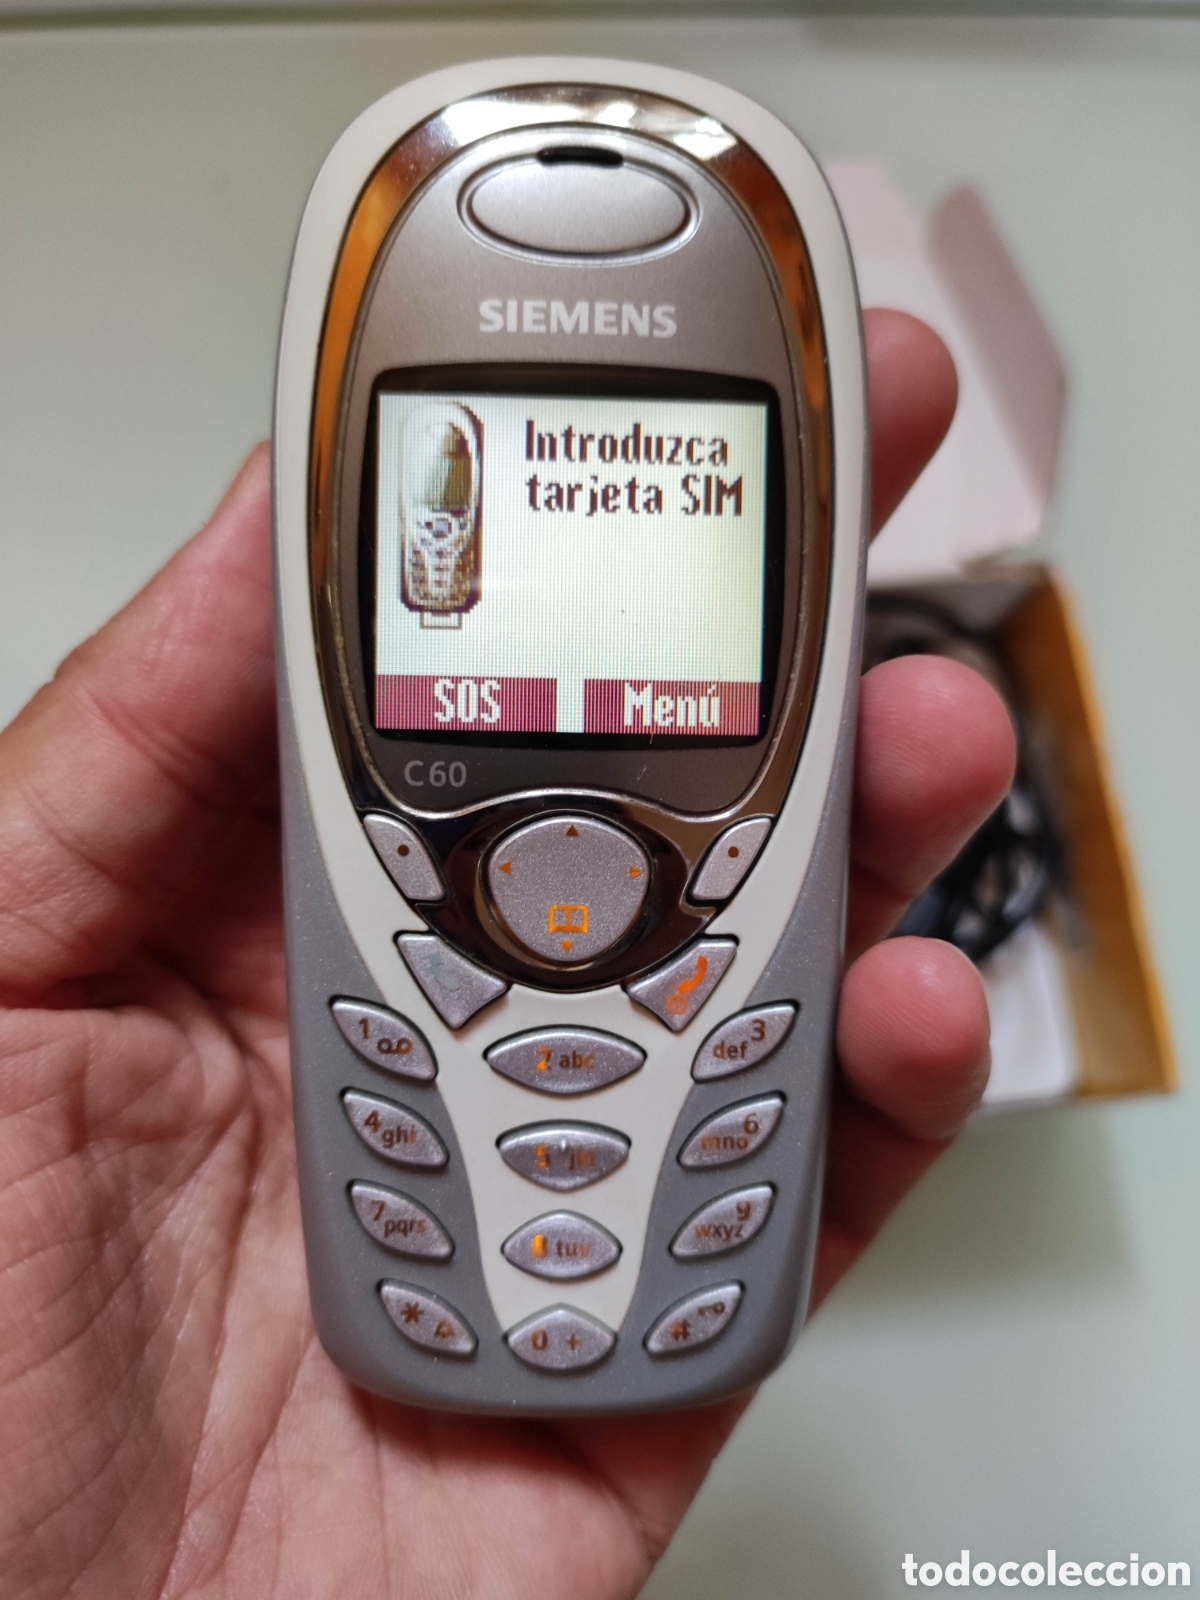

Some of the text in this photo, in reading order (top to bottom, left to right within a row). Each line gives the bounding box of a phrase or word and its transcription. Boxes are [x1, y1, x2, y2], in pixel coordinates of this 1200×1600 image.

[479, 298, 677, 338] SIEMENS
[525, 419, 728, 467] Introduzca
[525, 474, 743, 517] tarjeta SIM
[433, 677, 502, 725] SOS
[623, 681, 721, 728] Menú
[403, 759, 468, 788] C60
[358, 1017, 370, 1040] 1
[712, 1018, 767, 1061] def 3
[536, 1047, 596, 1072] 2 abc
[363, 1109, 418, 1149] 4 ghi
[743, 1112, 760, 1135] 6
[371, 1199, 427, 1239] 7 pqrs
[695, 1200, 752, 1243] wxyz 9
